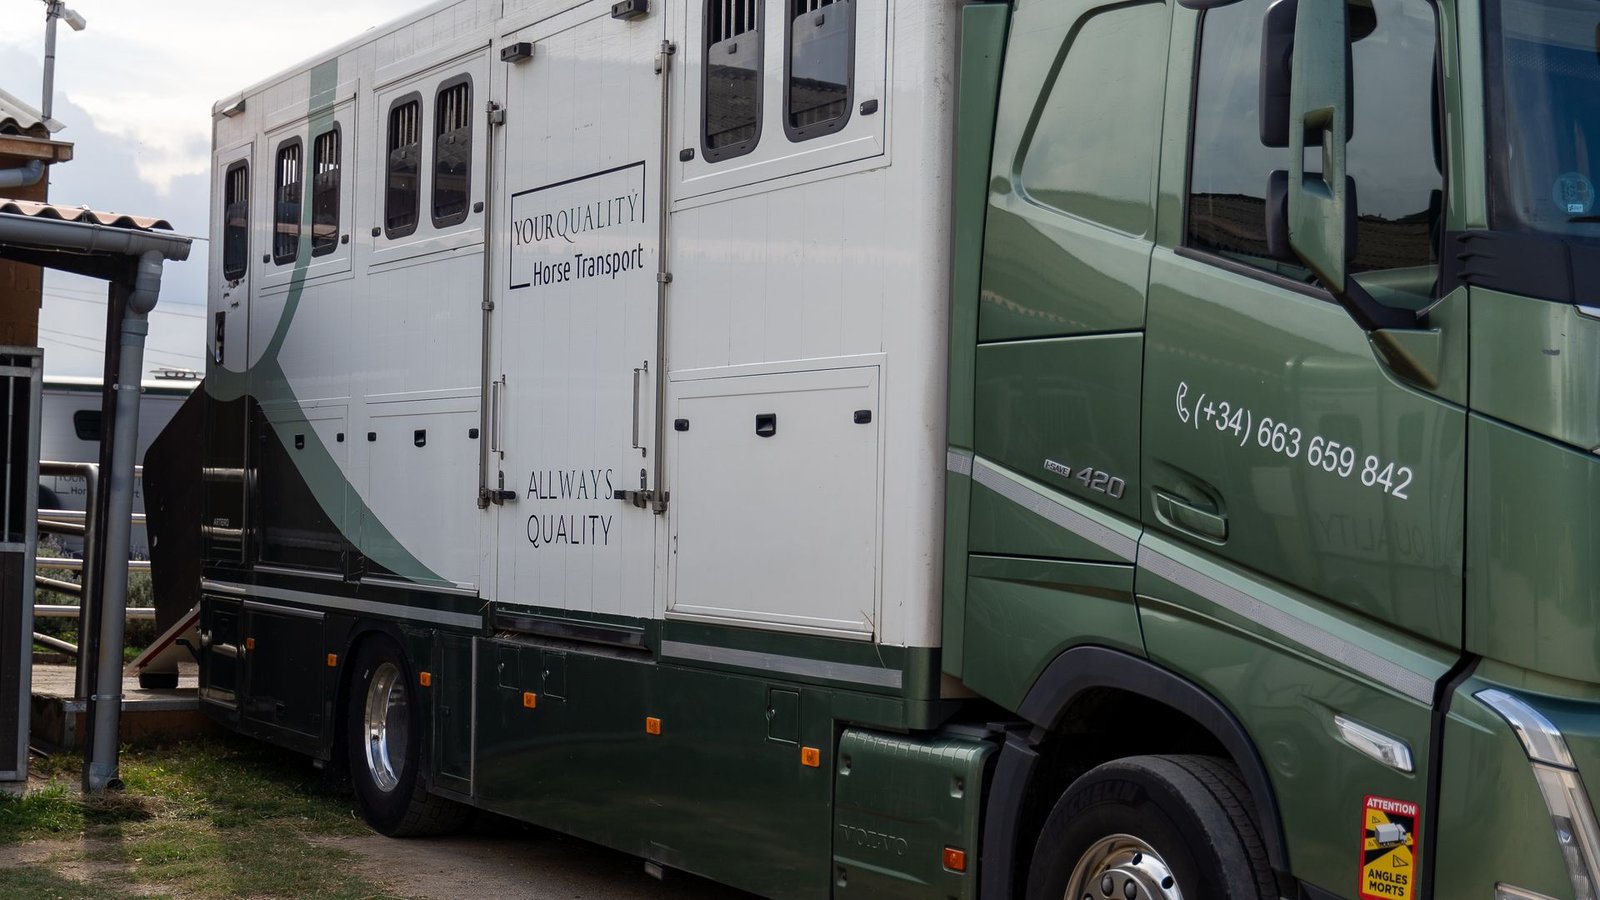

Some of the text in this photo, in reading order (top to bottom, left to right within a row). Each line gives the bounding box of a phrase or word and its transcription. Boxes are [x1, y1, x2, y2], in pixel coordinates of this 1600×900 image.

[533, 242, 644, 287] Horse Transport
[1194, 393, 1413, 501] (+34) 663 659 842
[526, 468, 613, 500] ALLWAYS
[1076, 467, 1125, 499] 420
[526, 514, 613, 549] QUALITY
[1367, 798, 1416, 815] ATTENTION
[1367, 868, 1408, 886] ANGLES
[1368, 880, 1405, 897] MORTS
